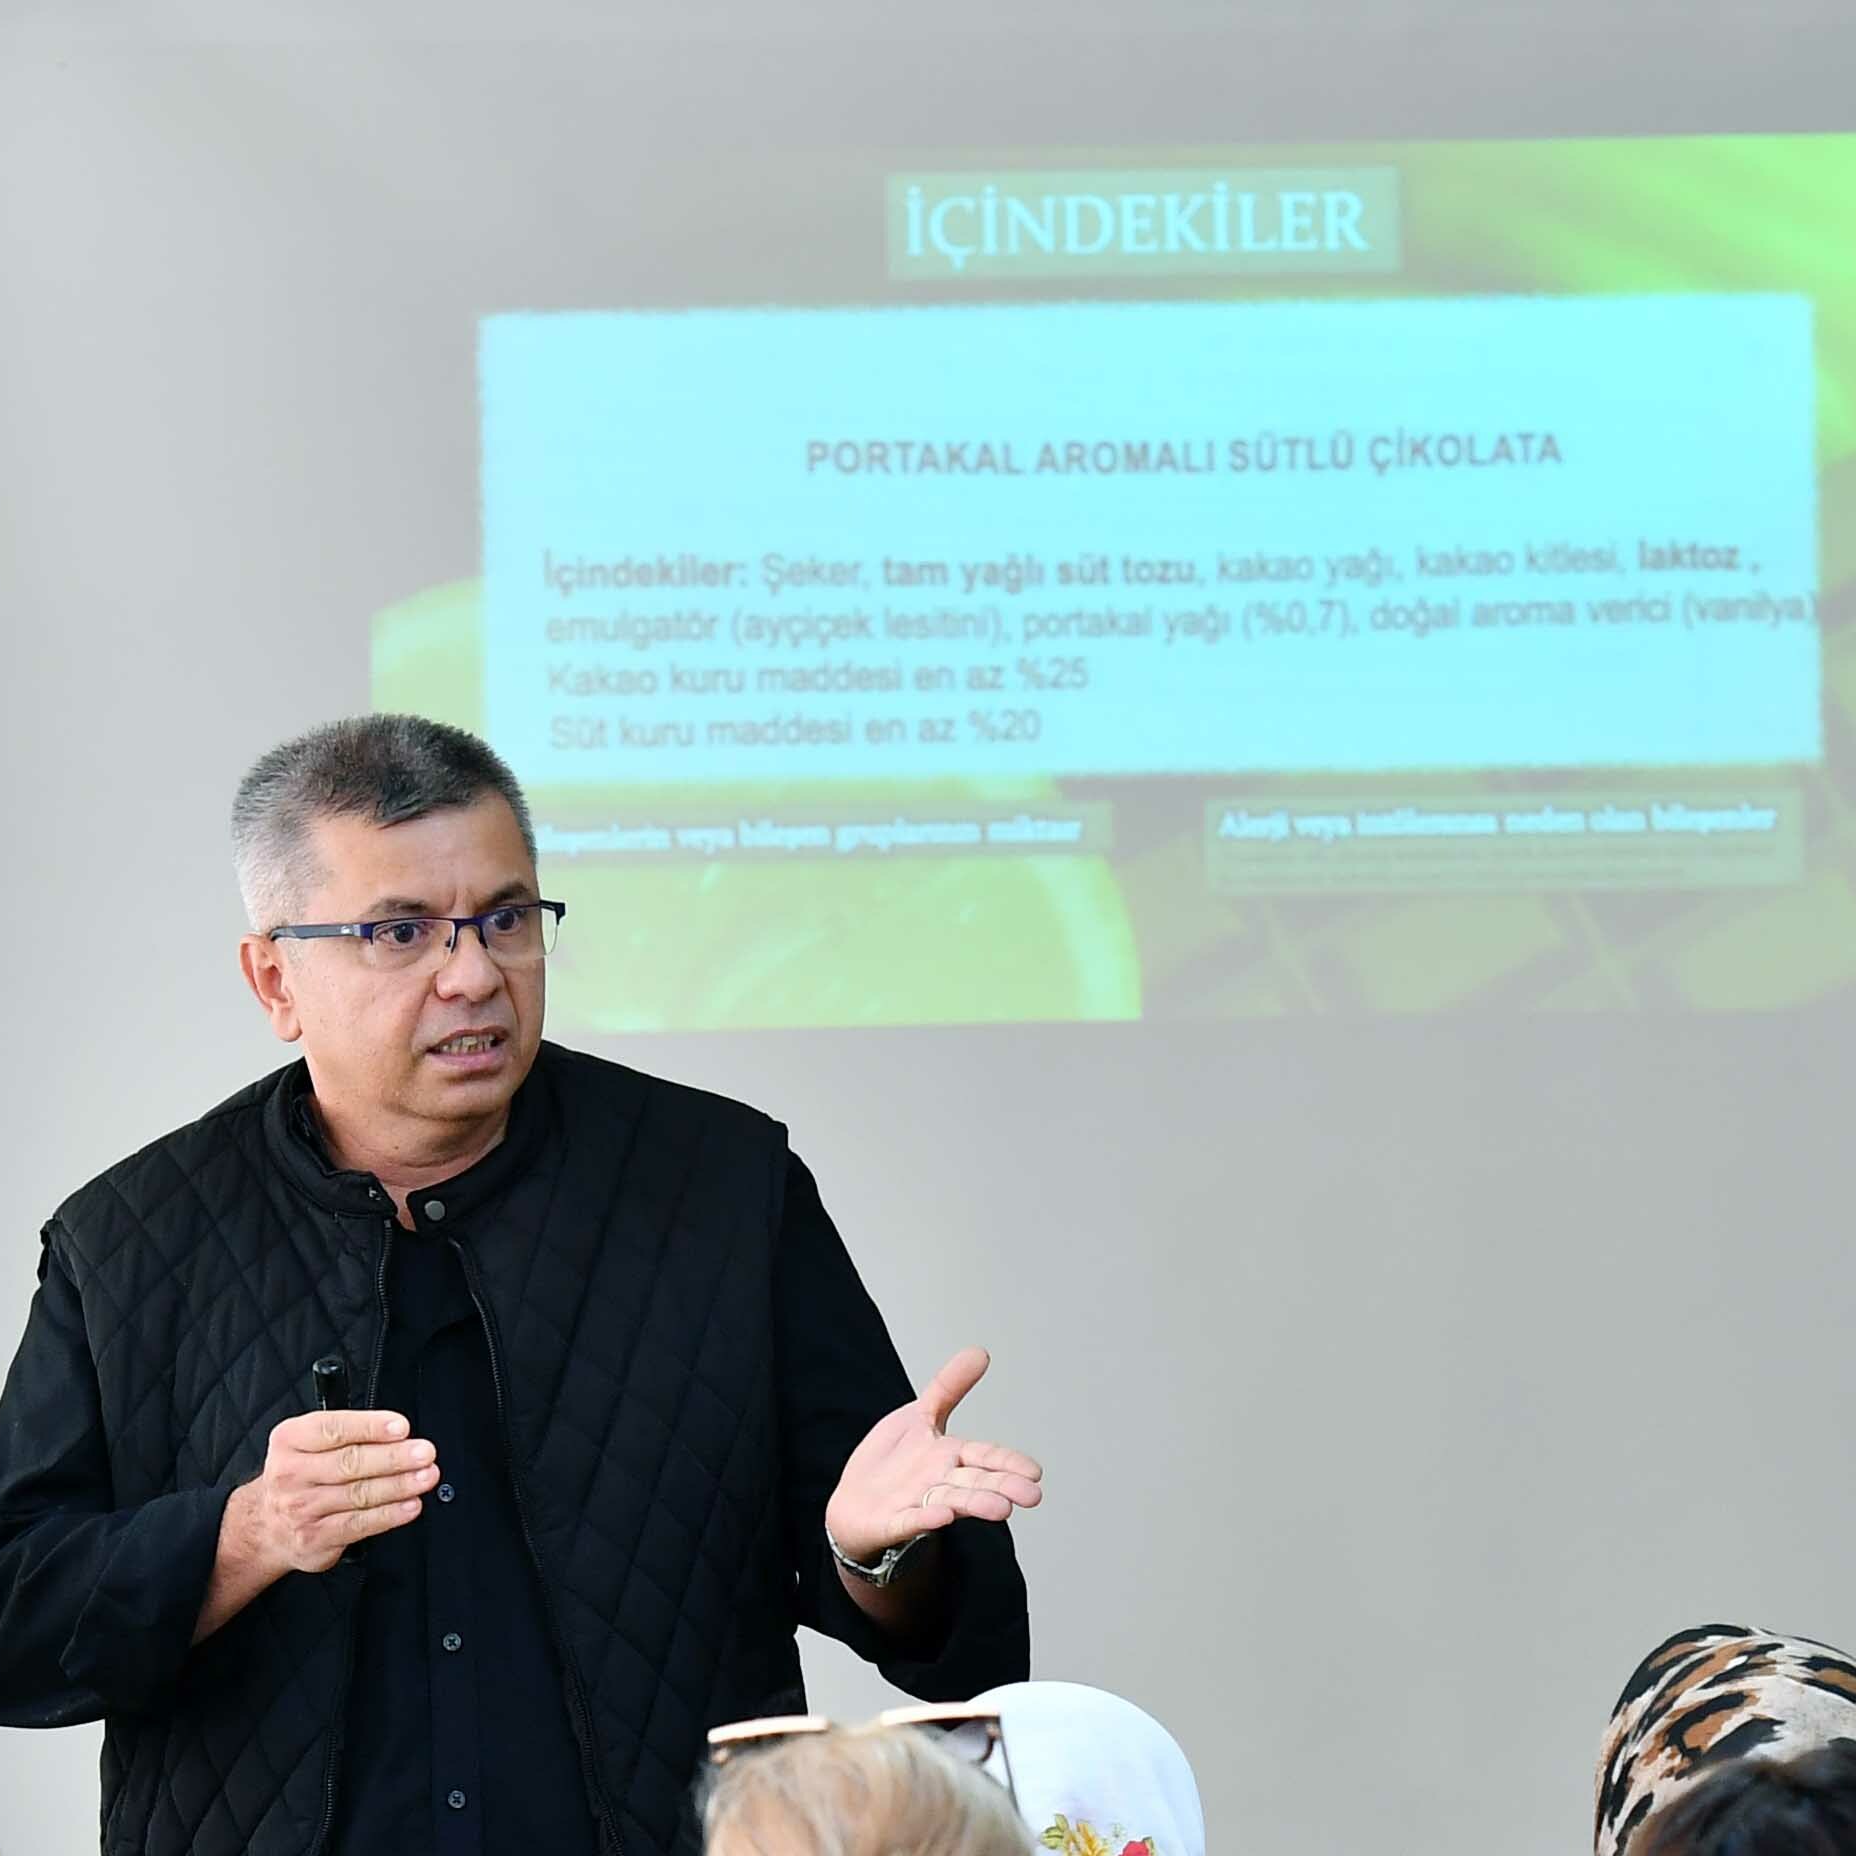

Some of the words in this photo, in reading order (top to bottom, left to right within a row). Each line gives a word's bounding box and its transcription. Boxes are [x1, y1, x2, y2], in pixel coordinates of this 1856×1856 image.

[907, 181, 1368, 269] İÇİNDEKİLER
[807, 441, 1024, 475] PORTAKAL
[1035, 441, 1215, 475] AROMALI
[1229, 431, 1354, 472] SÜTLÜ
[1368, 428, 1562, 476] ÇİKOLATA
